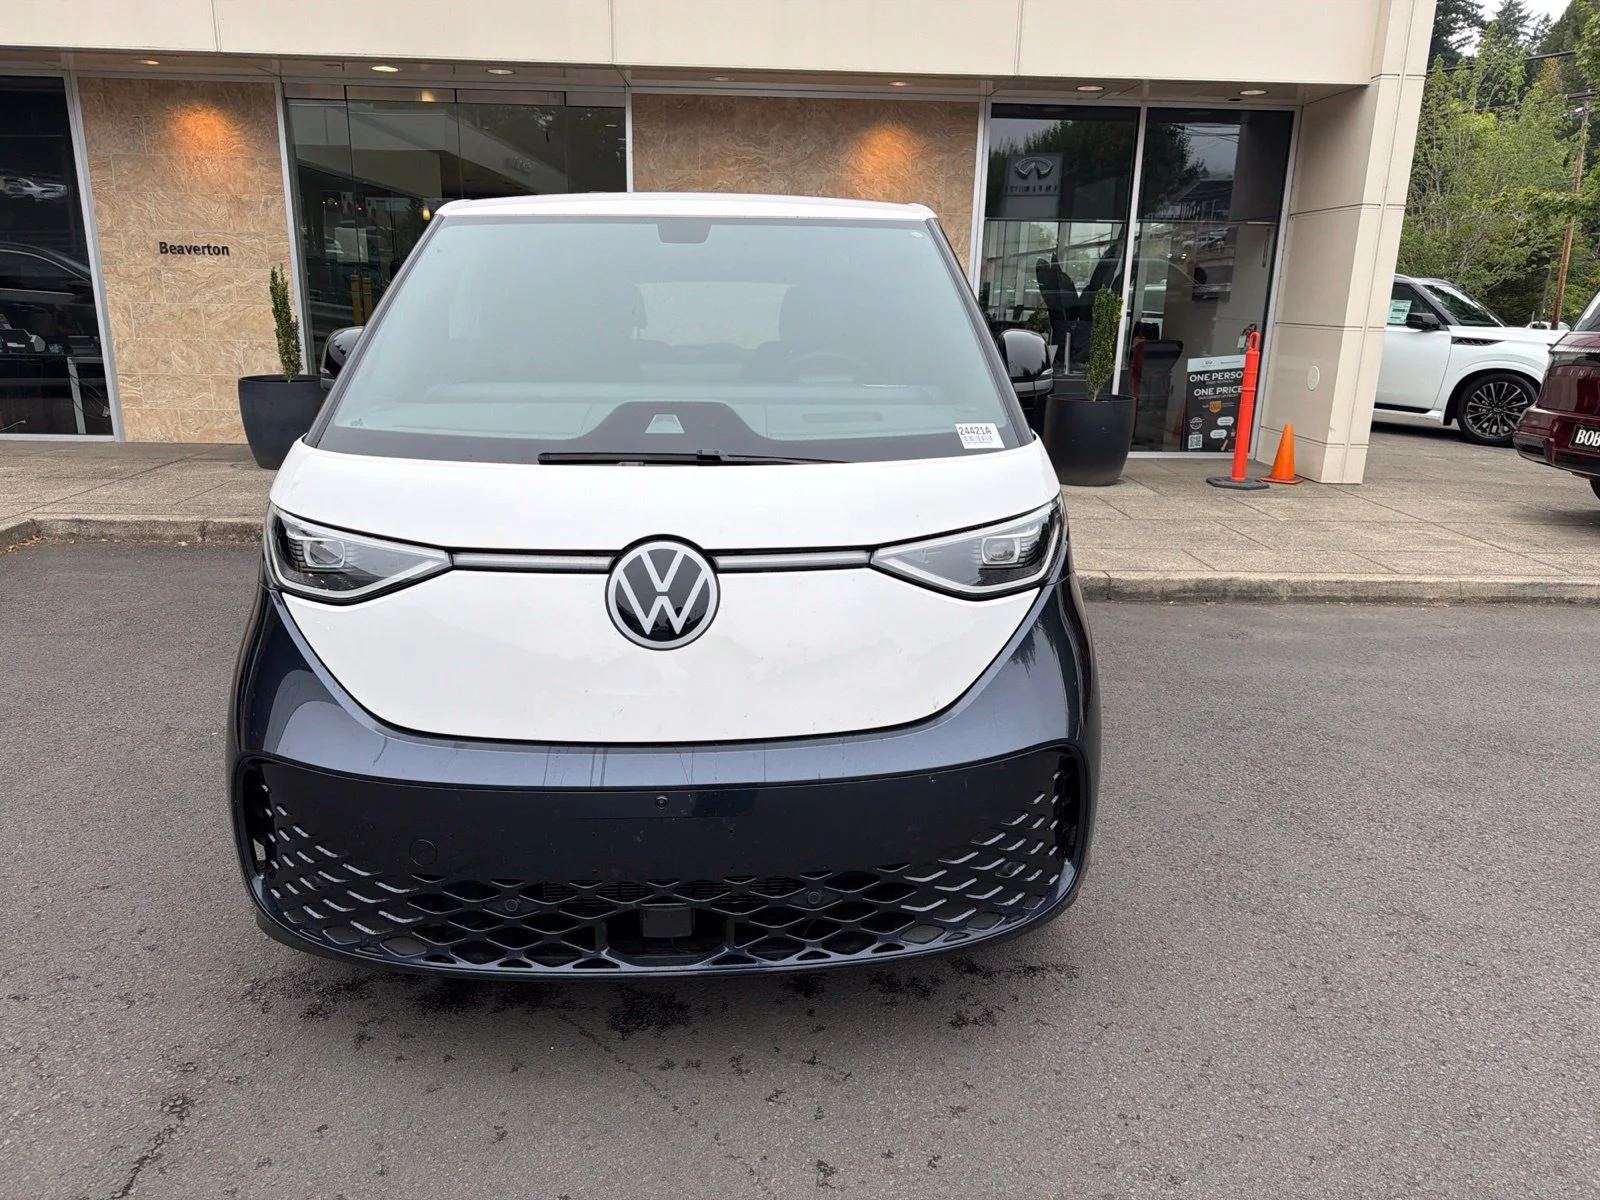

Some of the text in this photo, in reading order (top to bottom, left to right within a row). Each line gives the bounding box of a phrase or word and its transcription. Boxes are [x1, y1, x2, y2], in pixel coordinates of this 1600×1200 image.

[158, 241, 230, 257] Beaverton
[1189, 373, 1210, 382] ONE
[1212, 371, 1244, 381] PERSO
[1193, 387, 1215, 397] ONE
[1216, 385, 1243, 395] PRICE
[958, 426, 992, 436] 24421A
[613, 545, 711, 640] VW
